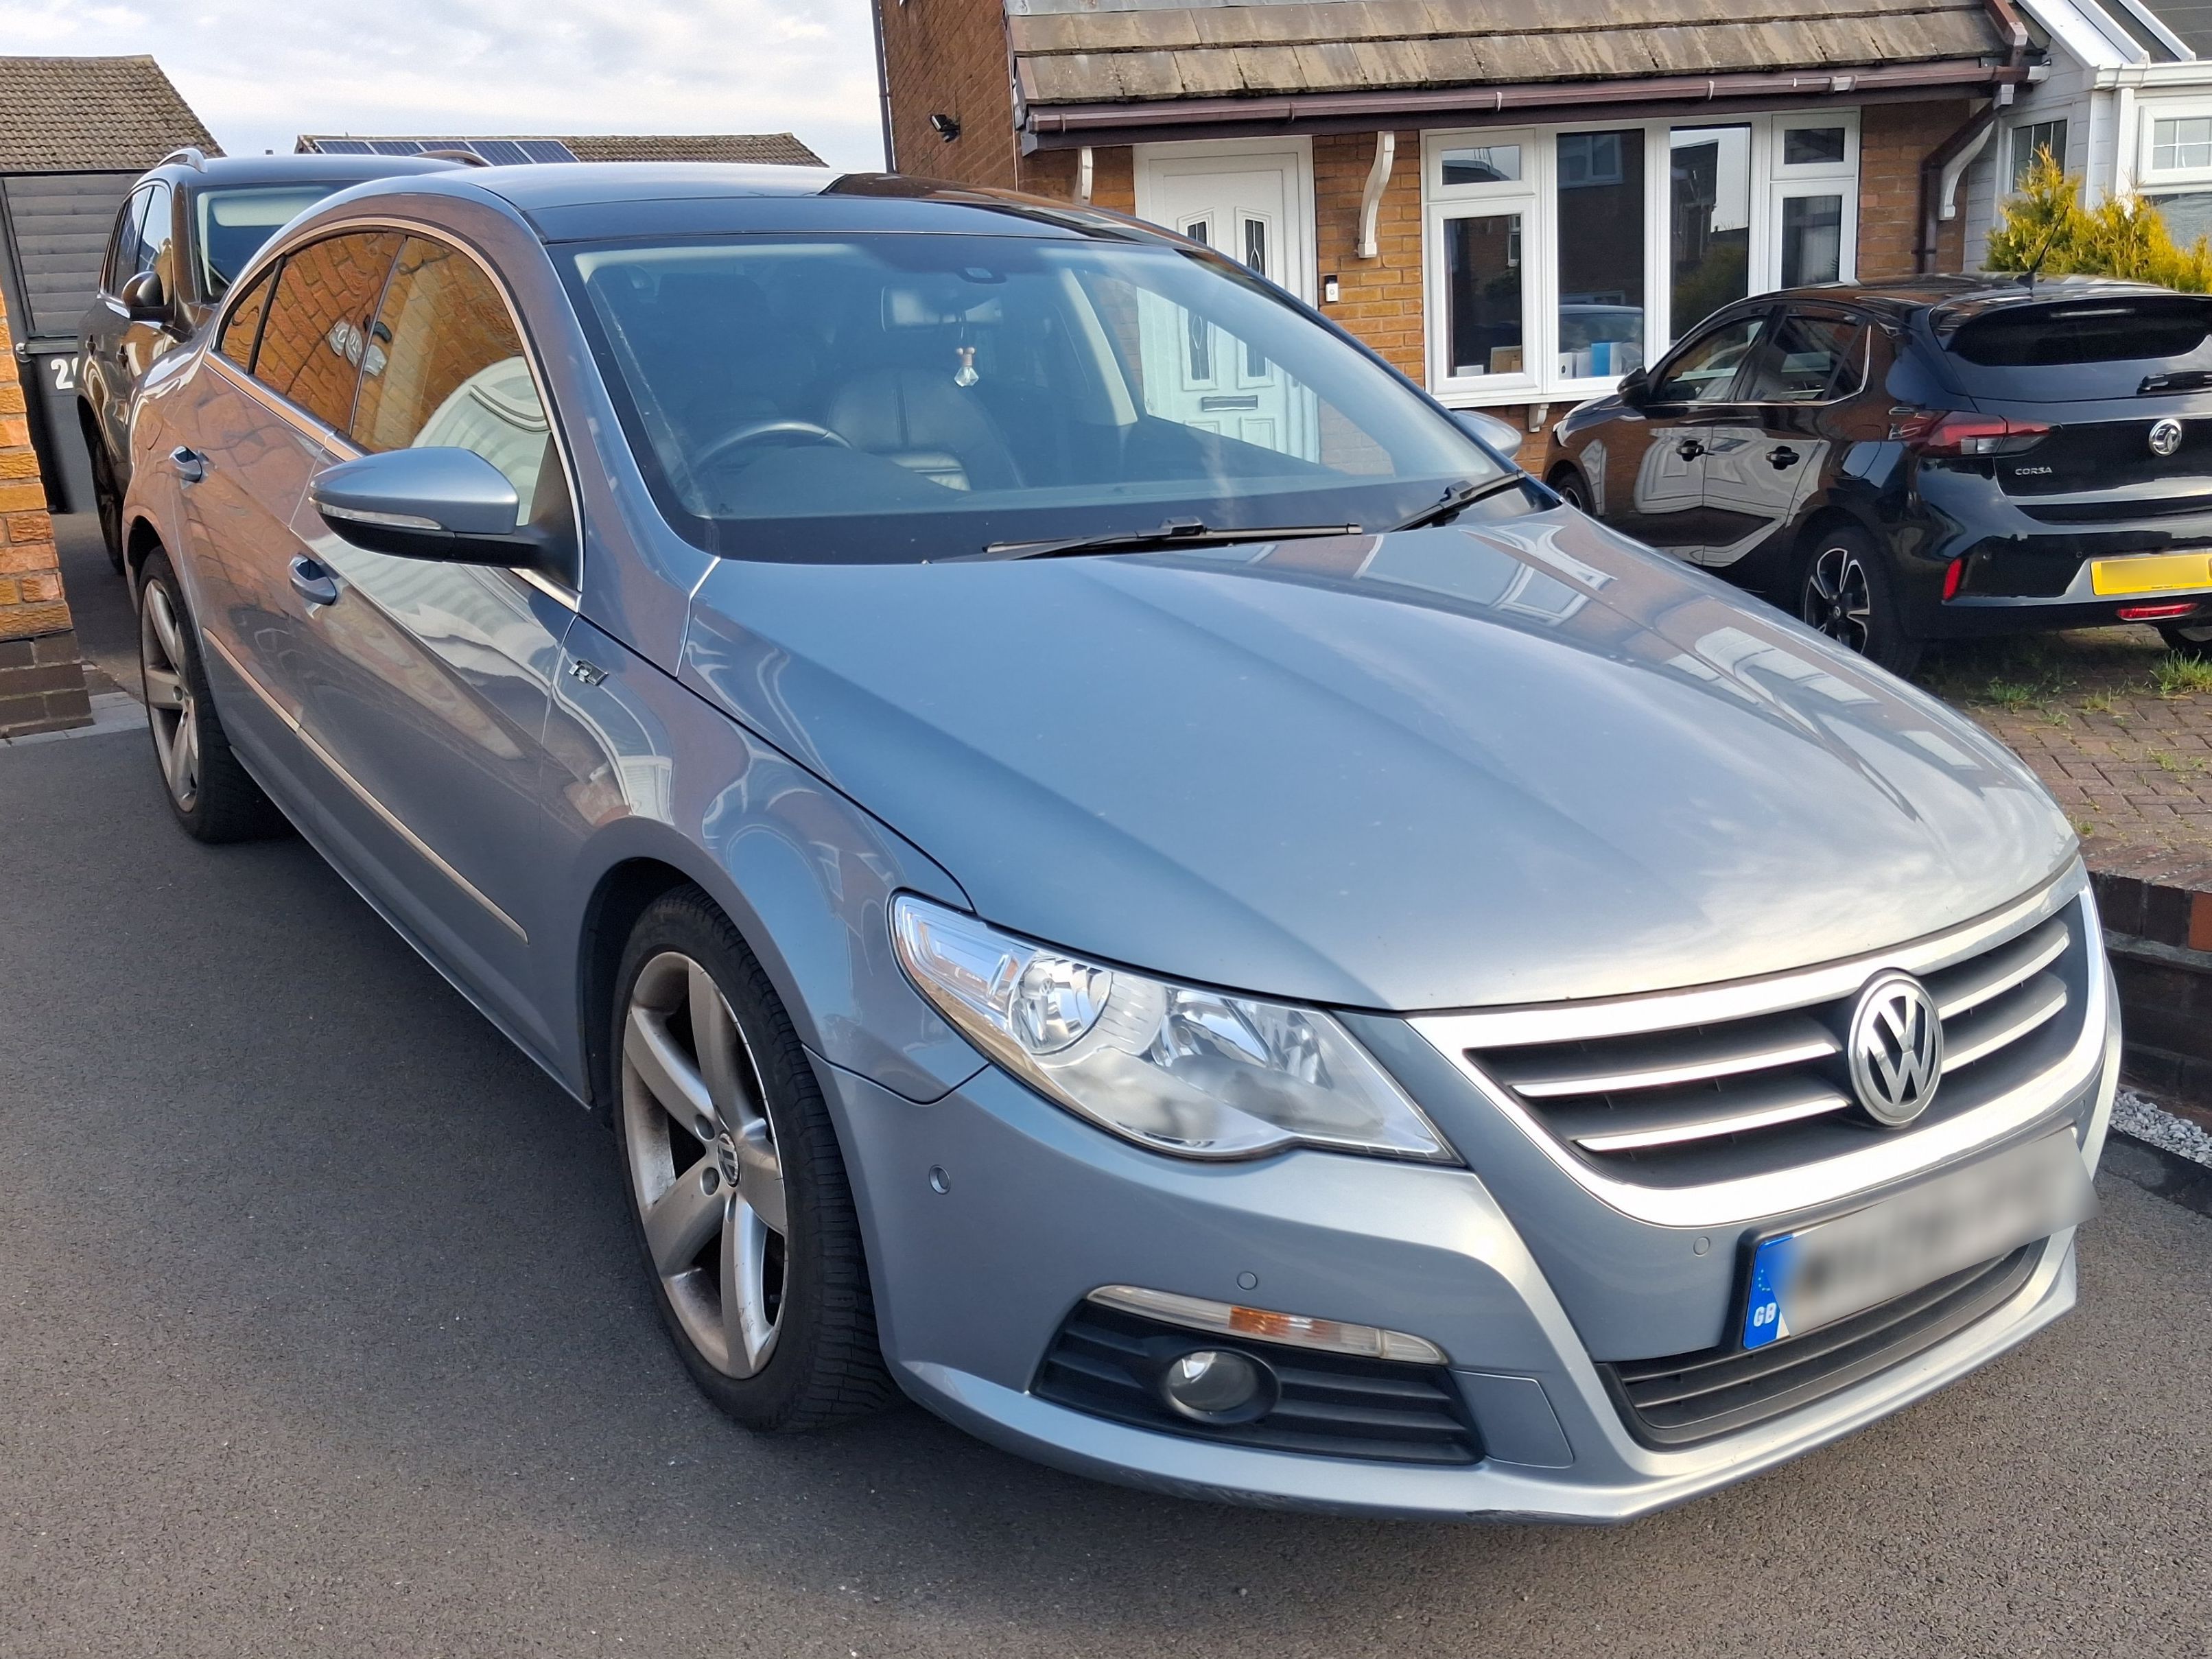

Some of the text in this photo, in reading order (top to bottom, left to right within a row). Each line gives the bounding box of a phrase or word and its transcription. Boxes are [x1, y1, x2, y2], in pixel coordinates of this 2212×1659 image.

[2015, 467, 2052, 475] CORSA
[1858, 985, 1935, 1113] VW
[1754, 1302, 1777, 1327] GB
